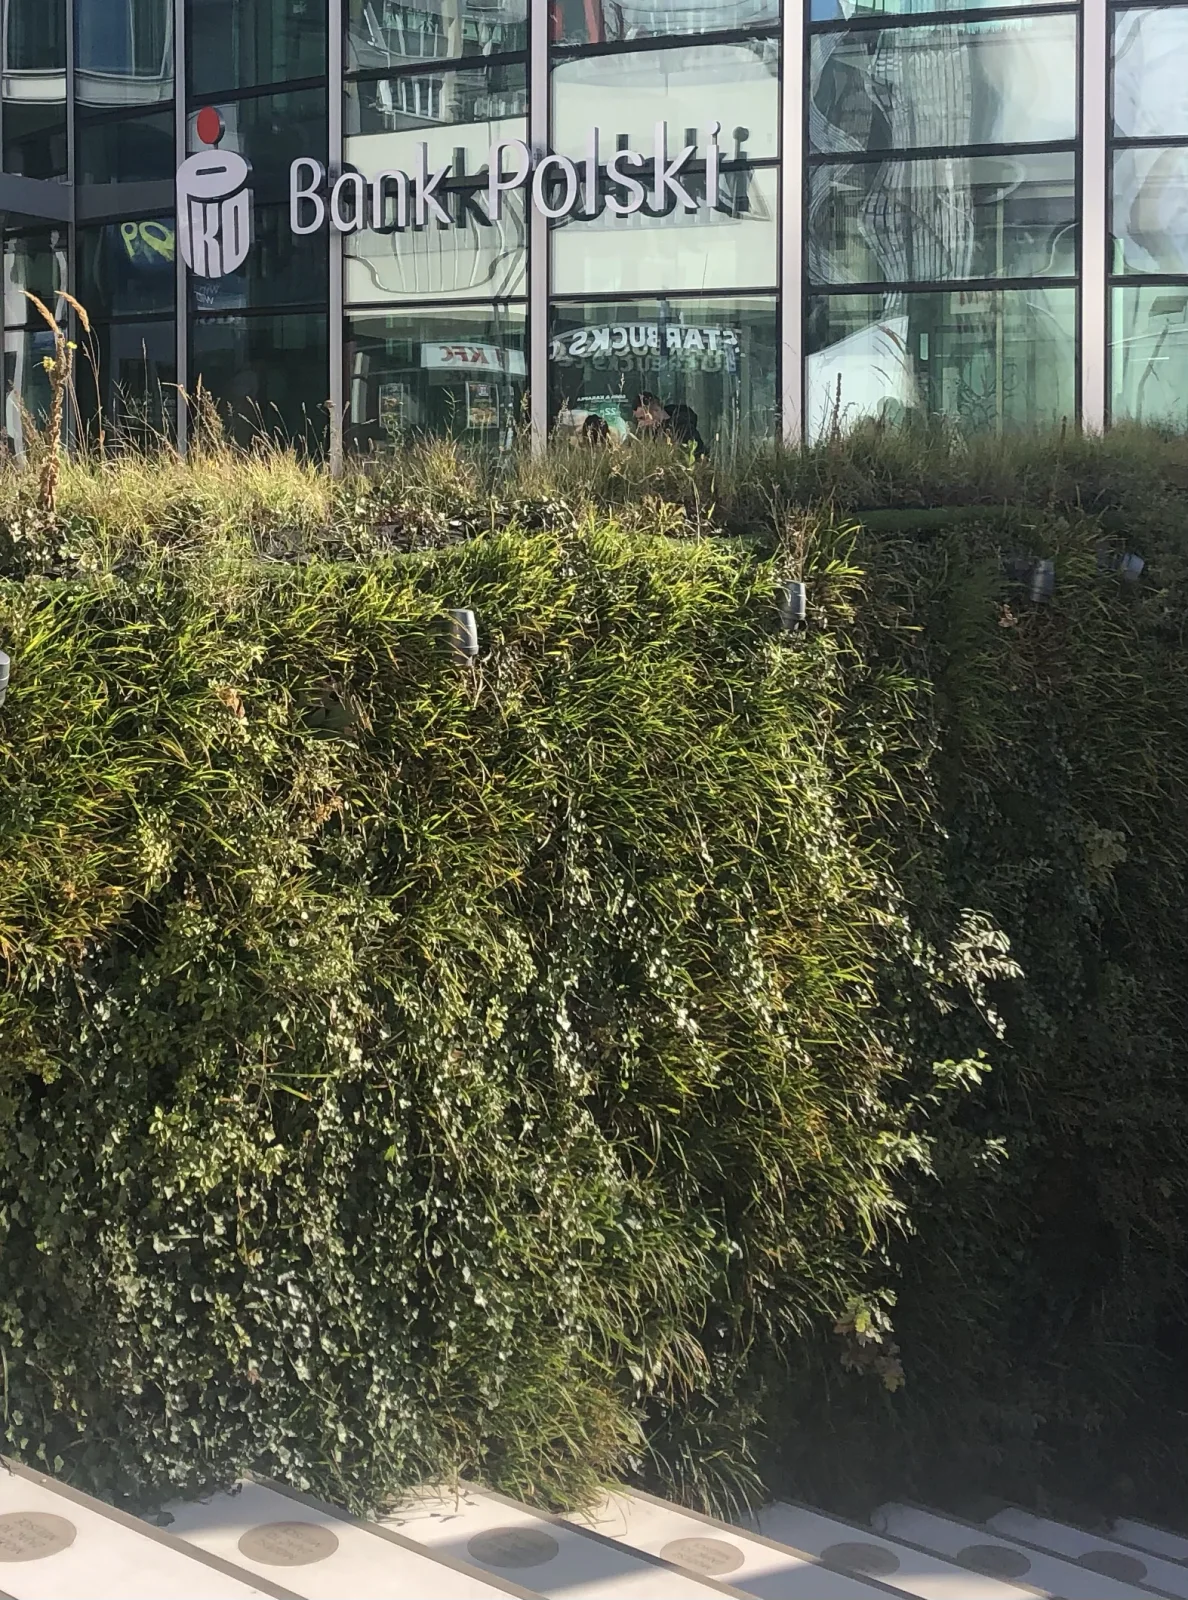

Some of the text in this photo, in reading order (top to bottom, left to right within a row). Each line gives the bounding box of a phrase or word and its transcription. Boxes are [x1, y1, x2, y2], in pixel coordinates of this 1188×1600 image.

[176, 149, 250, 278] PKO
[289, 120, 721, 235] Bank Polski
